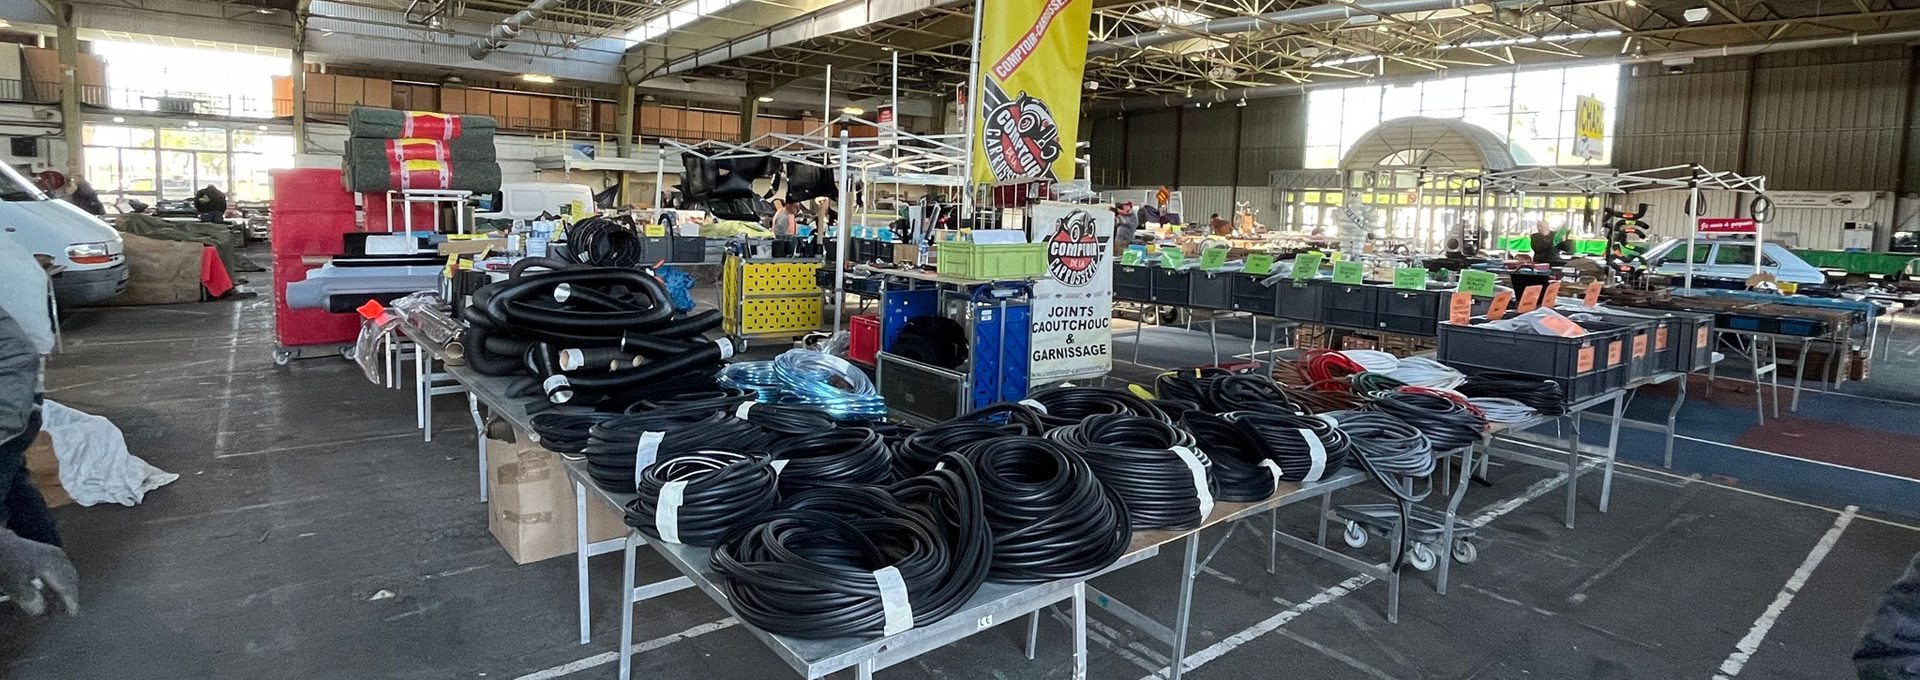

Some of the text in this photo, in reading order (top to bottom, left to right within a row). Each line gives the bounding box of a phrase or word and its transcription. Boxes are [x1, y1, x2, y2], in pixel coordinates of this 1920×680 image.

[997, 109, 1042, 178] COMPTOIR
[1051, 241, 1097, 256] COMPTOIR
[1071, 259, 1085, 268] DE LA
[1048, 306, 1094, 318] JOINTS
[1032, 317, 1109, 334] CAOUTCHOUC
[1065, 333, 1075, 345] &
[1032, 344, 1107, 362] GARNISSAGE
[980, 614, 991, 626] CE
